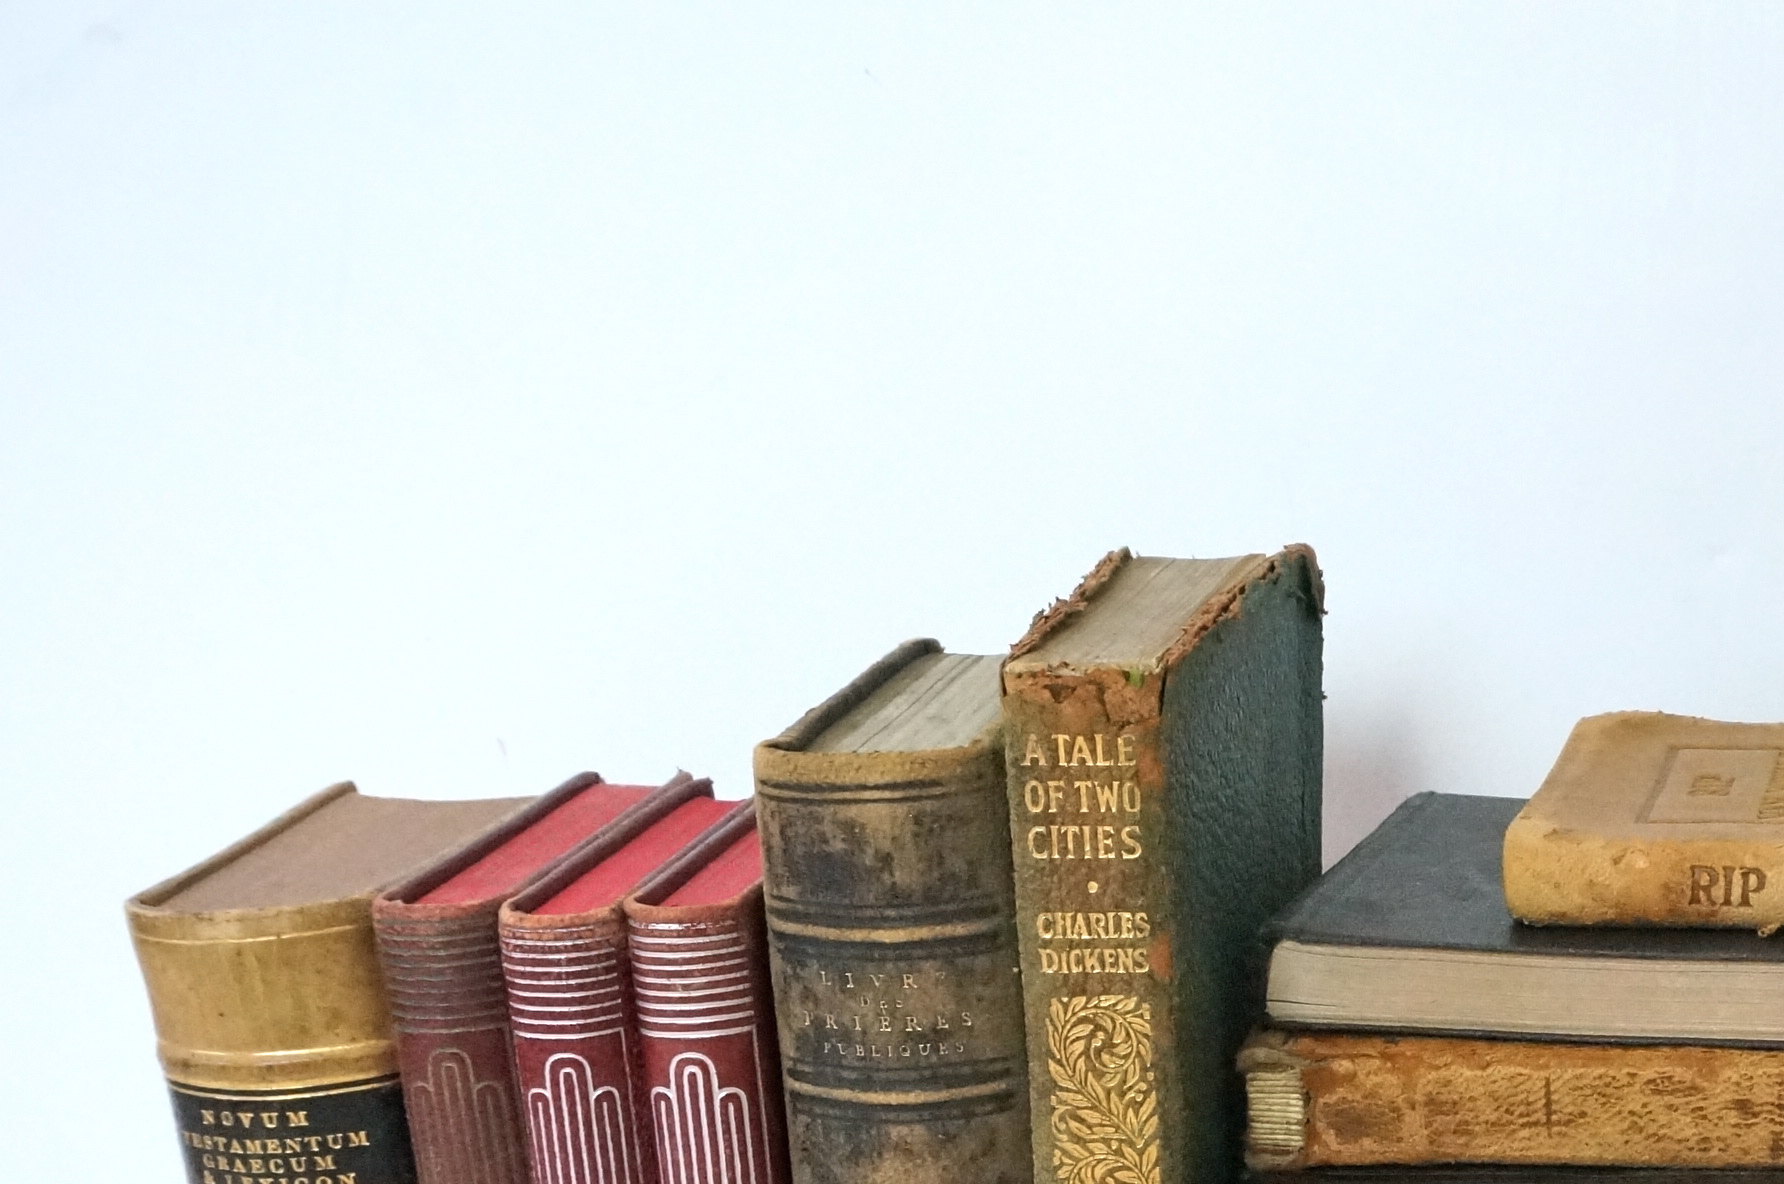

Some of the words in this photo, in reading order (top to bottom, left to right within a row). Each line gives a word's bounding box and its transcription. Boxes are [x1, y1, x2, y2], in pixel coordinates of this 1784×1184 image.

[1020, 733, 1047, 767] A
[1051, 733, 1137, 767] TALE
[1024, 780, 1065, 814] OF
[1073, 780, 1141, 814] TWO
[1027, 825, 1142, 860] CITIES
[1688, 864, 1767, 908] RIP
[1036, 911, 1150, 940] CHARLES
[1038, 948, 1150, 974] DICKENS
[823, 1040, 966, 1059] PUBLIQUES
[201, 1109, 309, 1128] NOVUM
[183, 1130, 371, 1155] TESTAMENTUM
[202, 1152, 338, 1175] GRAECUM
